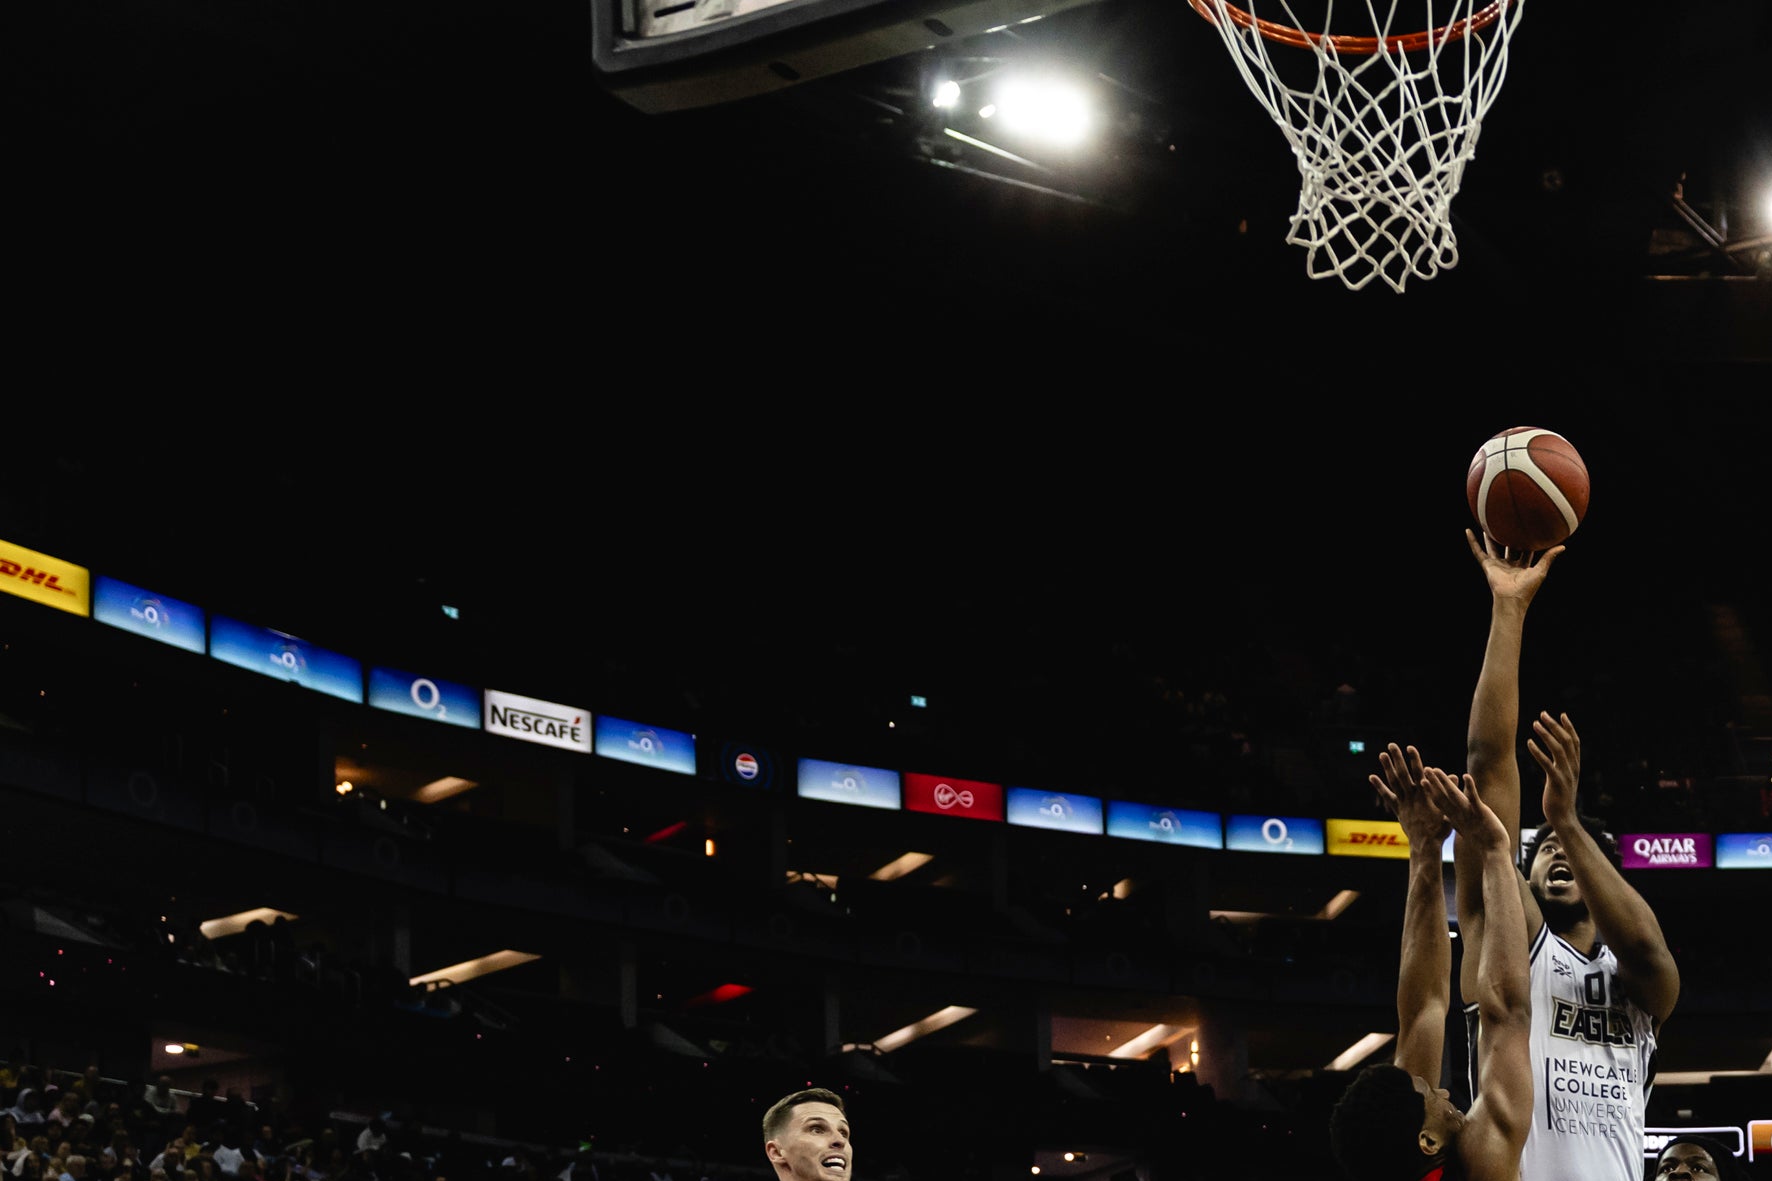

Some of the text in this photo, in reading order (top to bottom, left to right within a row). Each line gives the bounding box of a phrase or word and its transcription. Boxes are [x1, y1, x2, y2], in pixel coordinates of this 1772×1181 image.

[0, 559, 62, 592] DHL
[491, 703, 582, 743] NESCAFÉ
[1349, 832, 1401, 846] DHL
[1634, 838, 1695, 856] QATAR
[1584, 971, 1606, 1005] 0
[1554, 1077, 1627, 1101] COLLEGE
[1555, 1098, 1631, 1120] UNIVERSI
[1556, 1118, 1617, 1138] CENTRE
